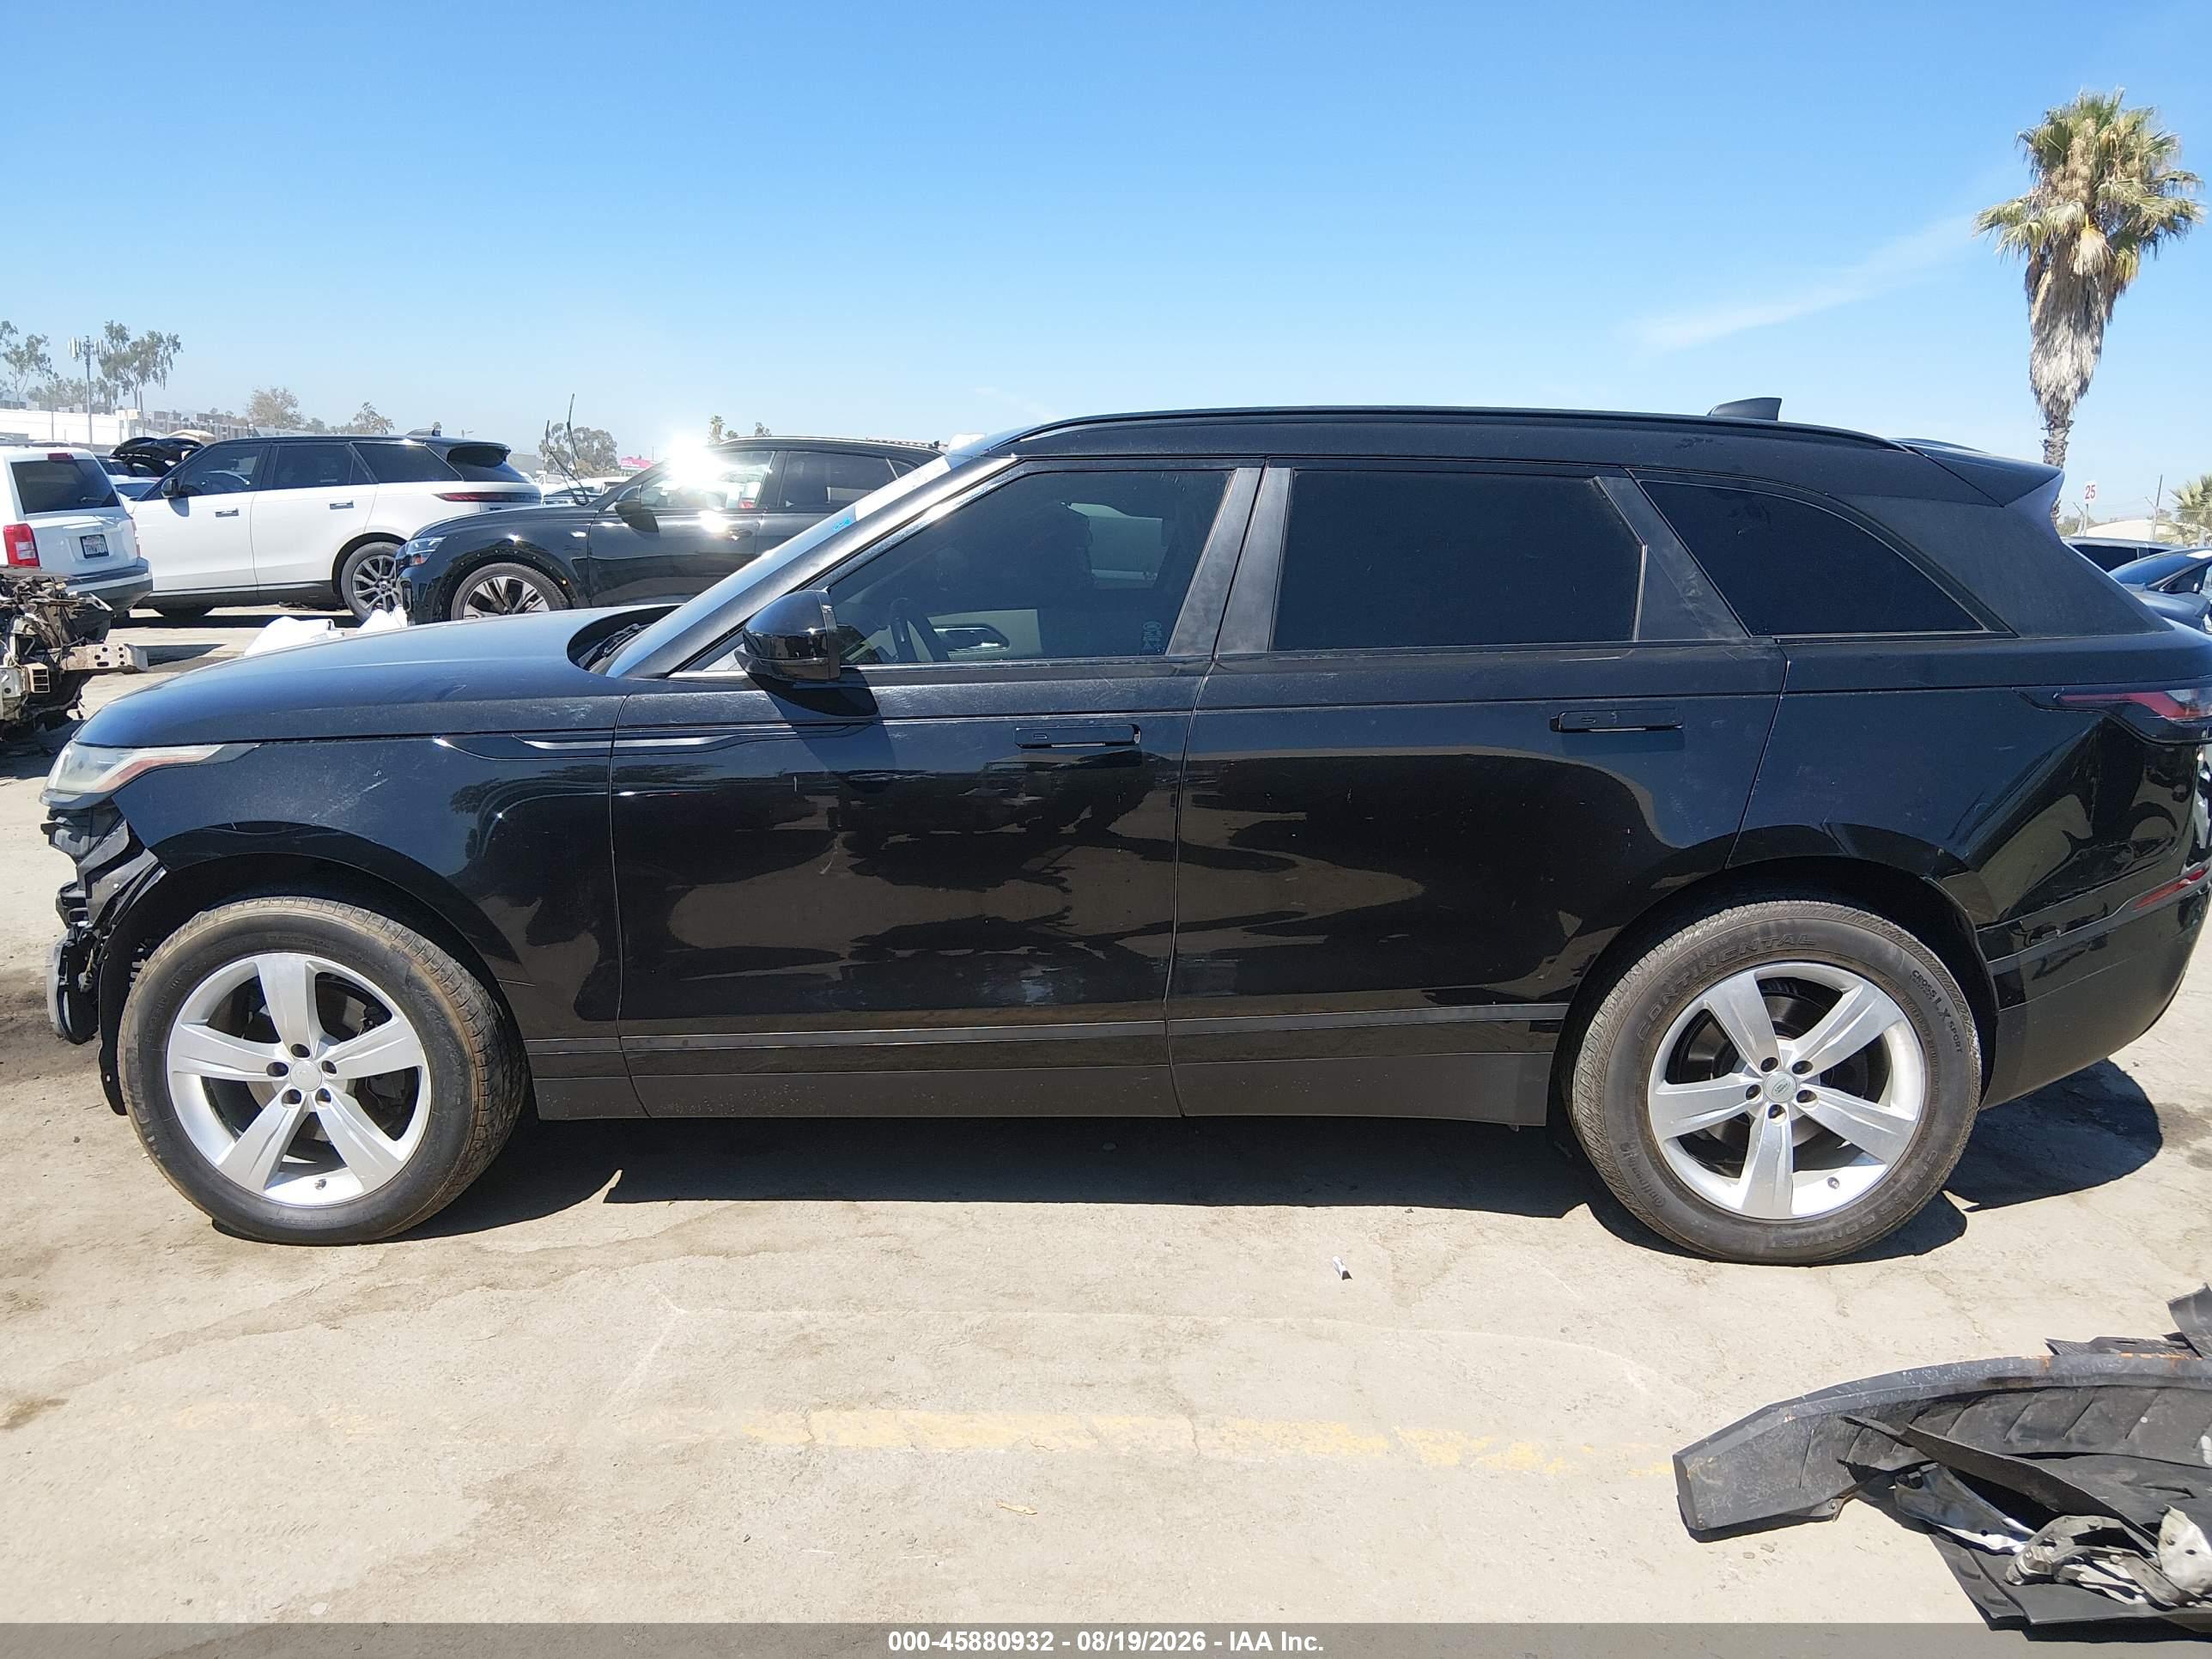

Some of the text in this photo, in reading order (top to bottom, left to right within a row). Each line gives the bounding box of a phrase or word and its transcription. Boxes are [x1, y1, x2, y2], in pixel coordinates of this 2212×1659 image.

[2085, 484, 2096, 499] 25
[1637, 933, 1816, 1042] CONTINENTAL
[1911, 969, 1937, 998] CROSS
[1949, 1020, 1963, 1054] SPORT
